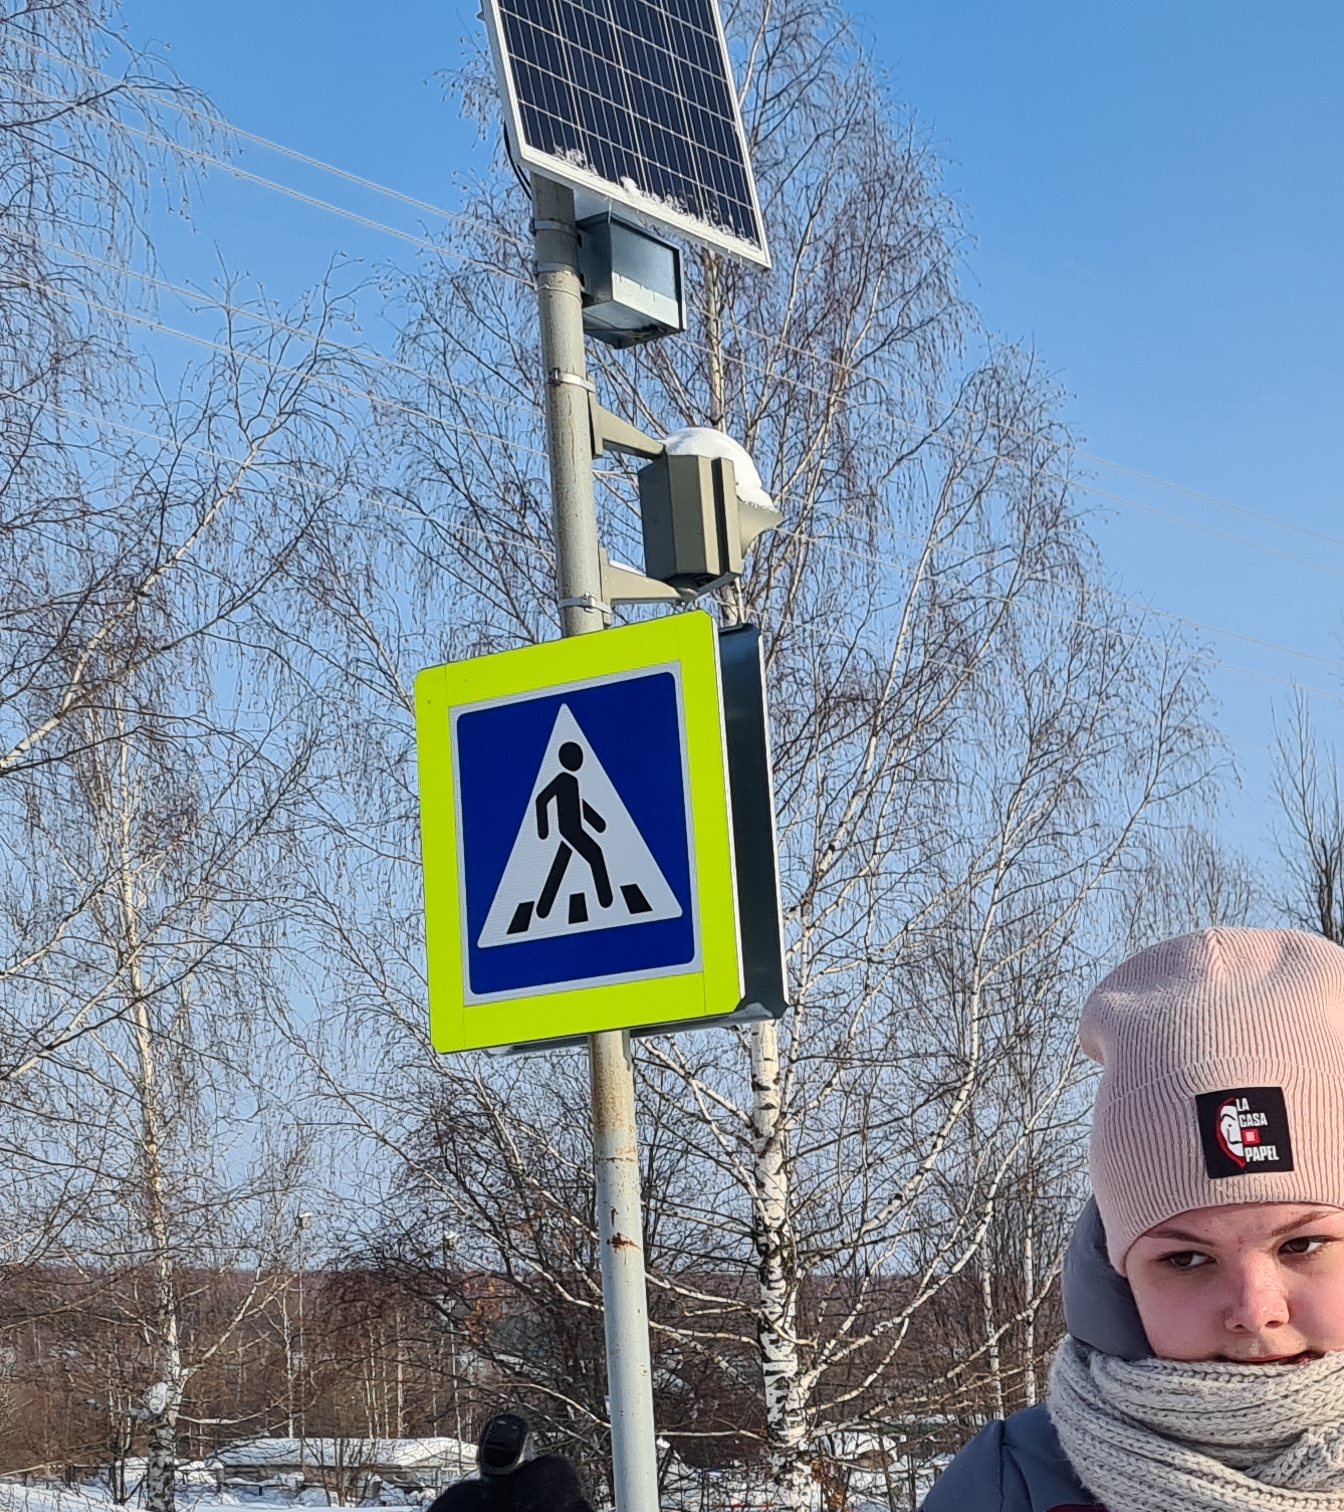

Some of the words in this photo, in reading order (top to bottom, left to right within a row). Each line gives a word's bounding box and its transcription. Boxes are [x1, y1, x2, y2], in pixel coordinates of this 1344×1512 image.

[1235, 1097, 1250, 1112] LA
[1238, 1112, 1268, 1128] CASA
[1244, 1144, 1280, 1163] PAPEL
